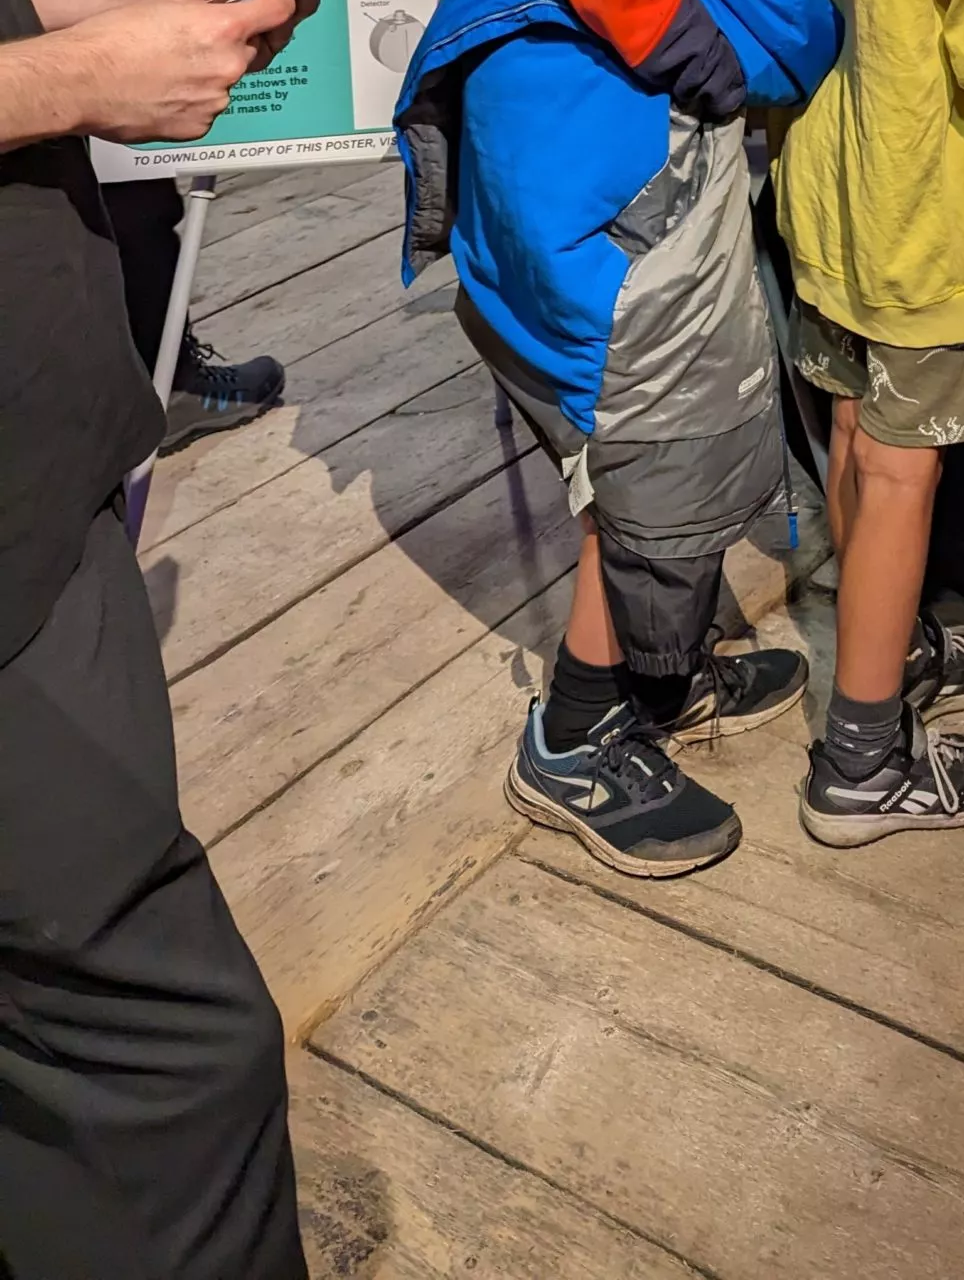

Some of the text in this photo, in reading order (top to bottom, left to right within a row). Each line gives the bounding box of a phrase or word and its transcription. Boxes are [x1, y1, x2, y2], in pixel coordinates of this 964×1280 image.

[360, 0, 391, 8] Detector
[250, 79, 287, 89] shows
[290, 76, 308, 86] the
[230, 89, 289, 102] pounds by
[237, 104, 268, 114] mass
[270, 103, 282, 112] to
[133, 156, 150, 166] TO
[153, 150, 225, 166] DOWNLOAD
[227, 149, 237, 158] A
[239, 146, 272, 158] COPY
[276, 144, 294, 156] OF
[295, 141, 322, 154] THIS
[325, 138, 376, 151] POSTER,
[879, 779, 912, 813] Reebok
